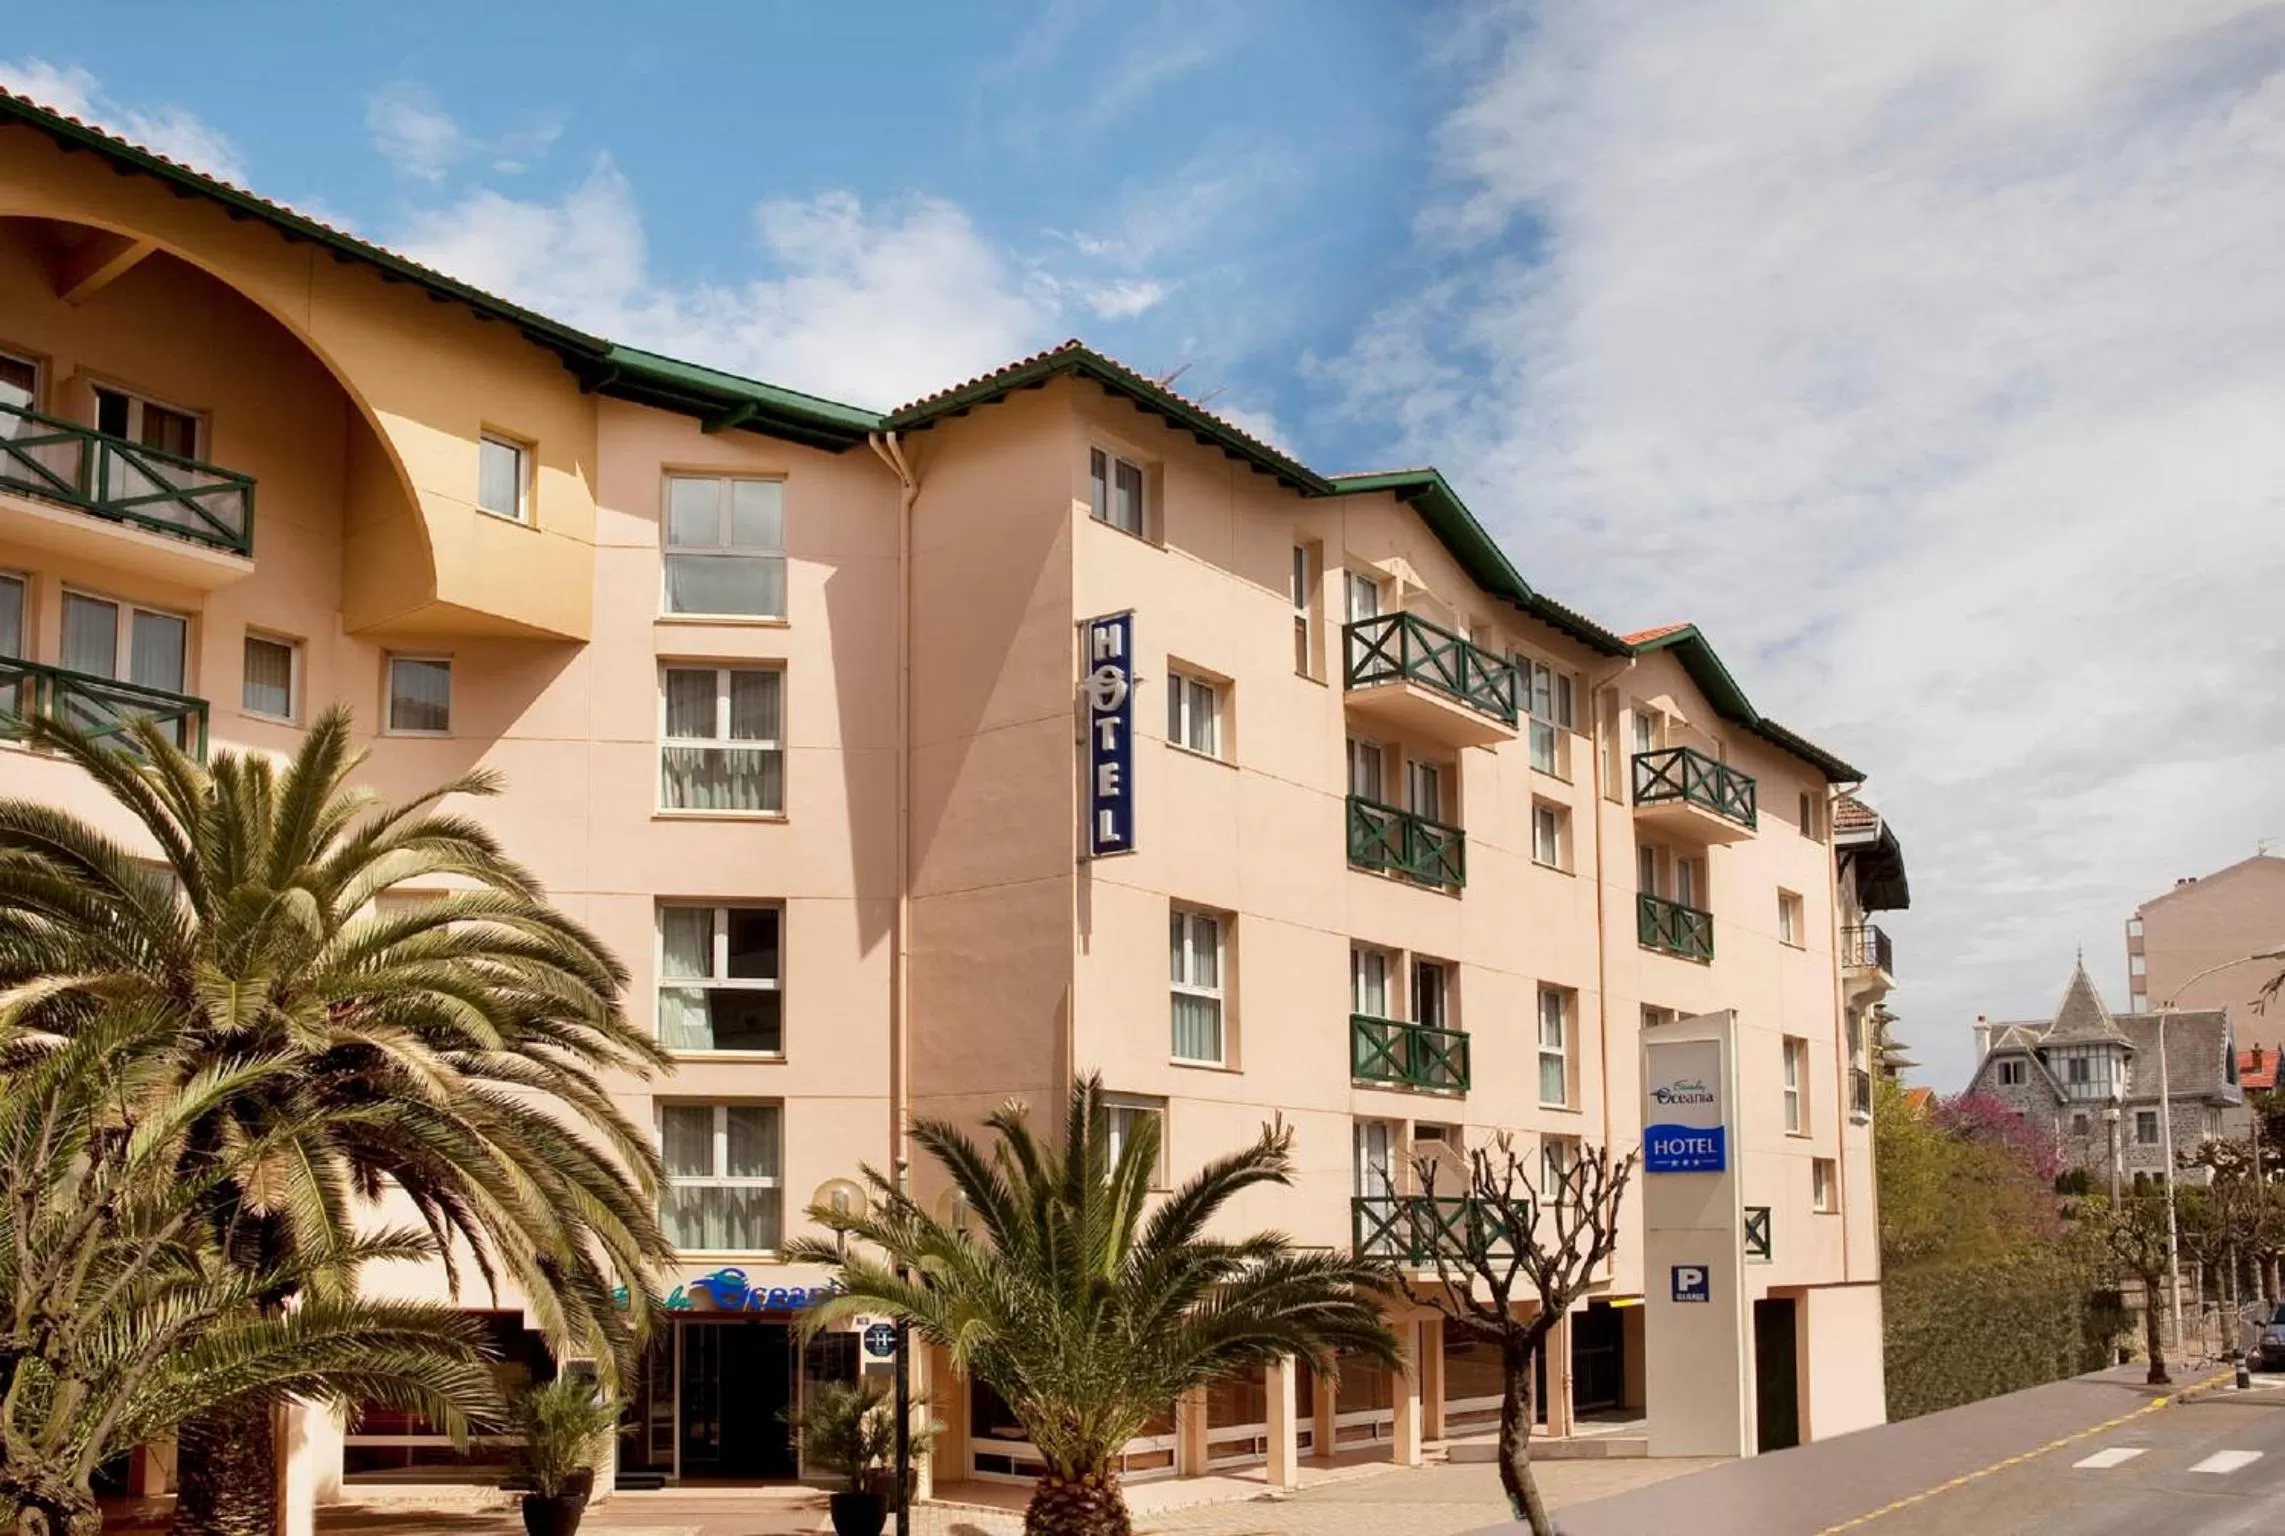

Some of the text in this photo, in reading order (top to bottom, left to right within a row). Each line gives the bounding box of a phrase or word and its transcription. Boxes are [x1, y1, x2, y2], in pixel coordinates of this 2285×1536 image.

[1091, 622, 1128, 844] HOTEL
[1654, 1138, 1719, 1156] HOTEL
[1678, 1268, 1702, 1291] P
